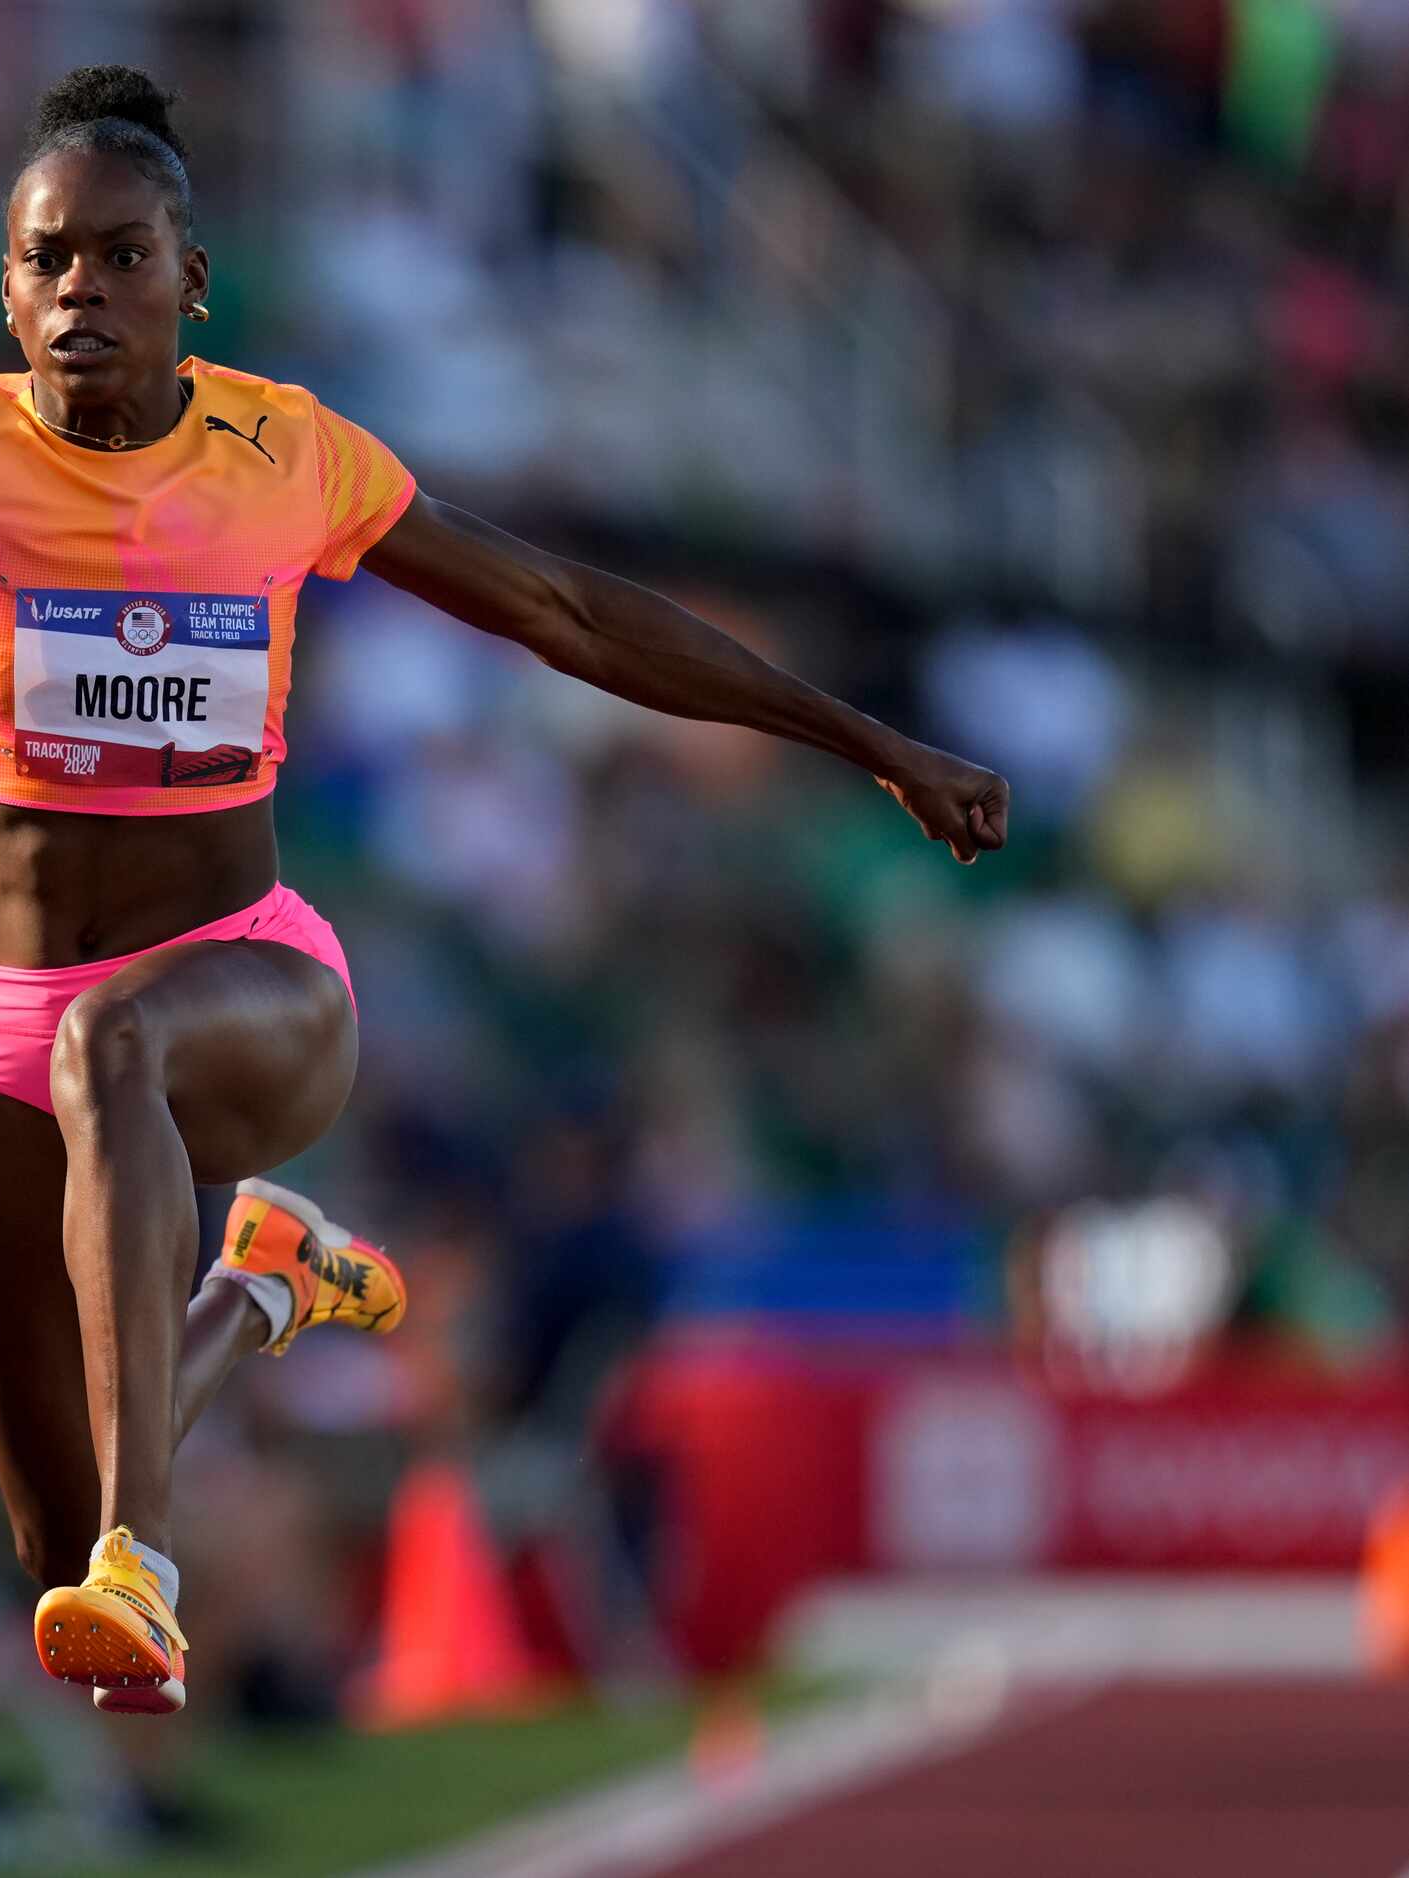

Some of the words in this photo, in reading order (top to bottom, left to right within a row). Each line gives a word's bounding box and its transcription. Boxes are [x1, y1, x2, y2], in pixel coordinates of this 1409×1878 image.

[53, 607, 102, 620] USATF
[189, 602, 209, 615] U.S.
[212, 603, 255, 617] OLYMPIC
[189, 616, 217, 629] TEAM
[219, 617, 255, 631] TRIALS
[191, 630, 213, 640] TRACK
[221, 631, 240, 640] FIELD
[75, 674, 211, 722] MOORE
[24, 741, 101, 762] TRACKTOWN
[64, 759, 96, 775] 2024
